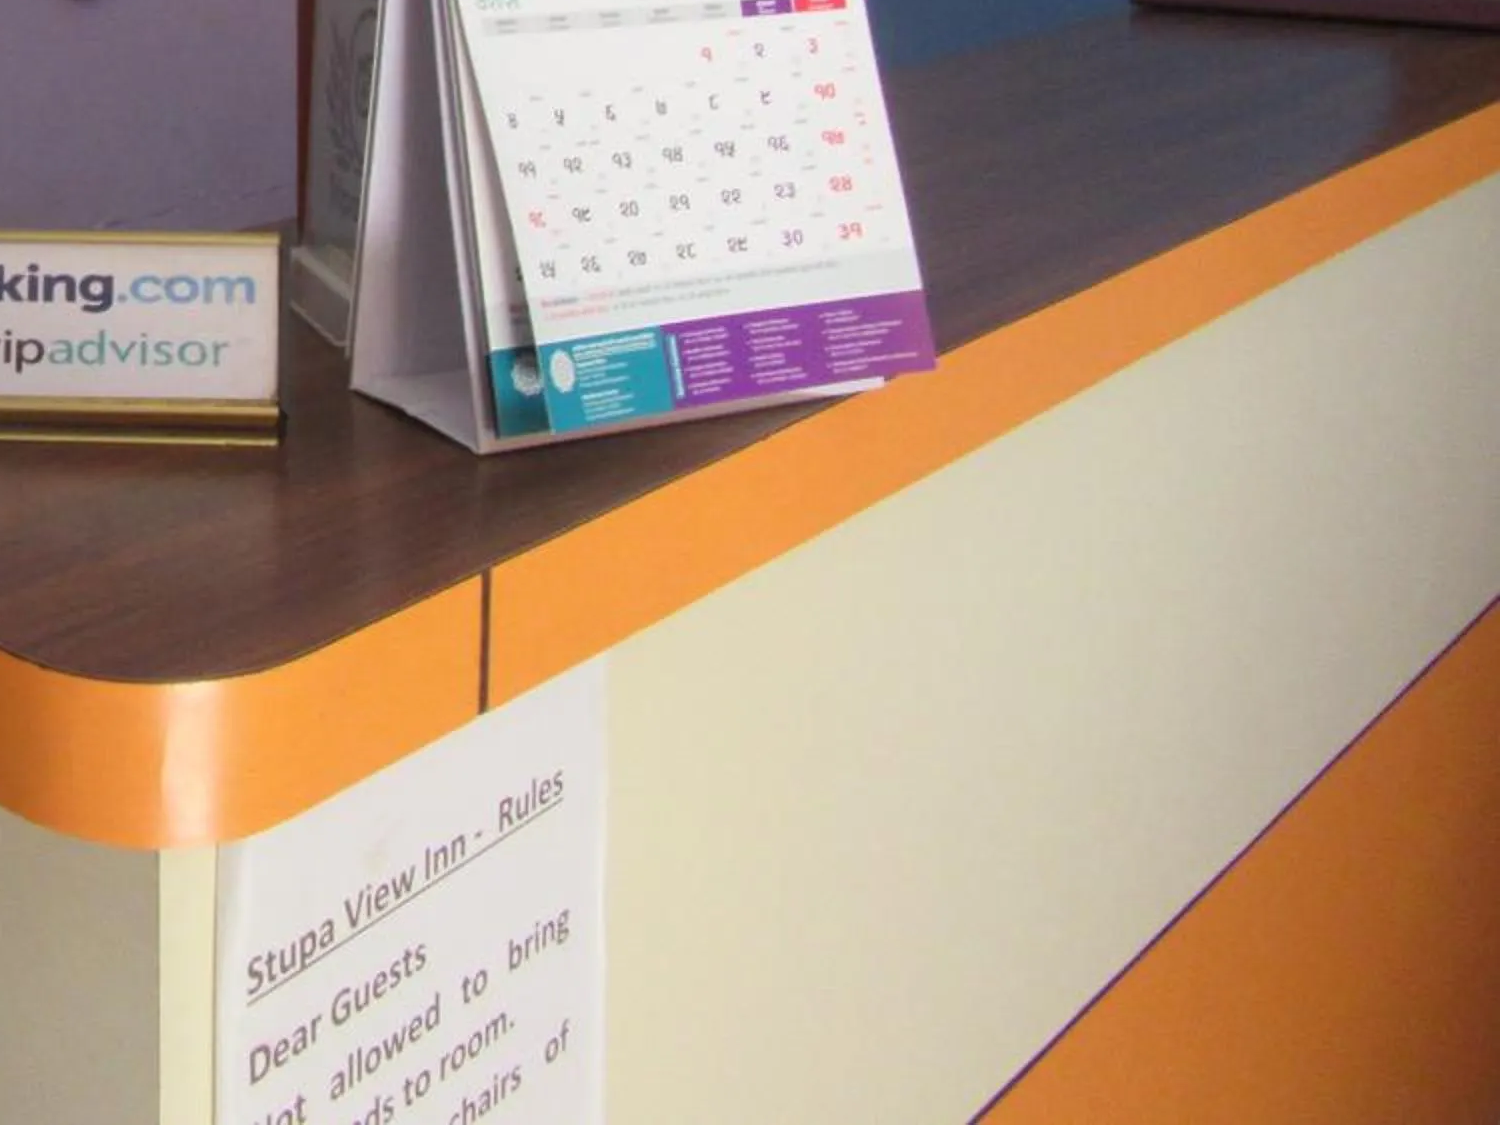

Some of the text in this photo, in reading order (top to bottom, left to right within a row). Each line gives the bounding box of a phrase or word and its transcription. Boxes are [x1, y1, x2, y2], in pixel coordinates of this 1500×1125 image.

[246, 916, 336, 997] Stupa
[343, 864, 415, 930] View
[424, 833, 467, 881] Inn
[498, 768, 564, 834] Rules
[248, 941, 427, 1086] Dear Guests
[329, 992, 441, 1101] allowed
[462, 967, 488, 1005] to
[508, 908, 570, 972] bring
[404, 1070, 431, 1107] to
[440, 1011, 516, 1082] room.
[449, 1019, 570, 1125] chairs of
